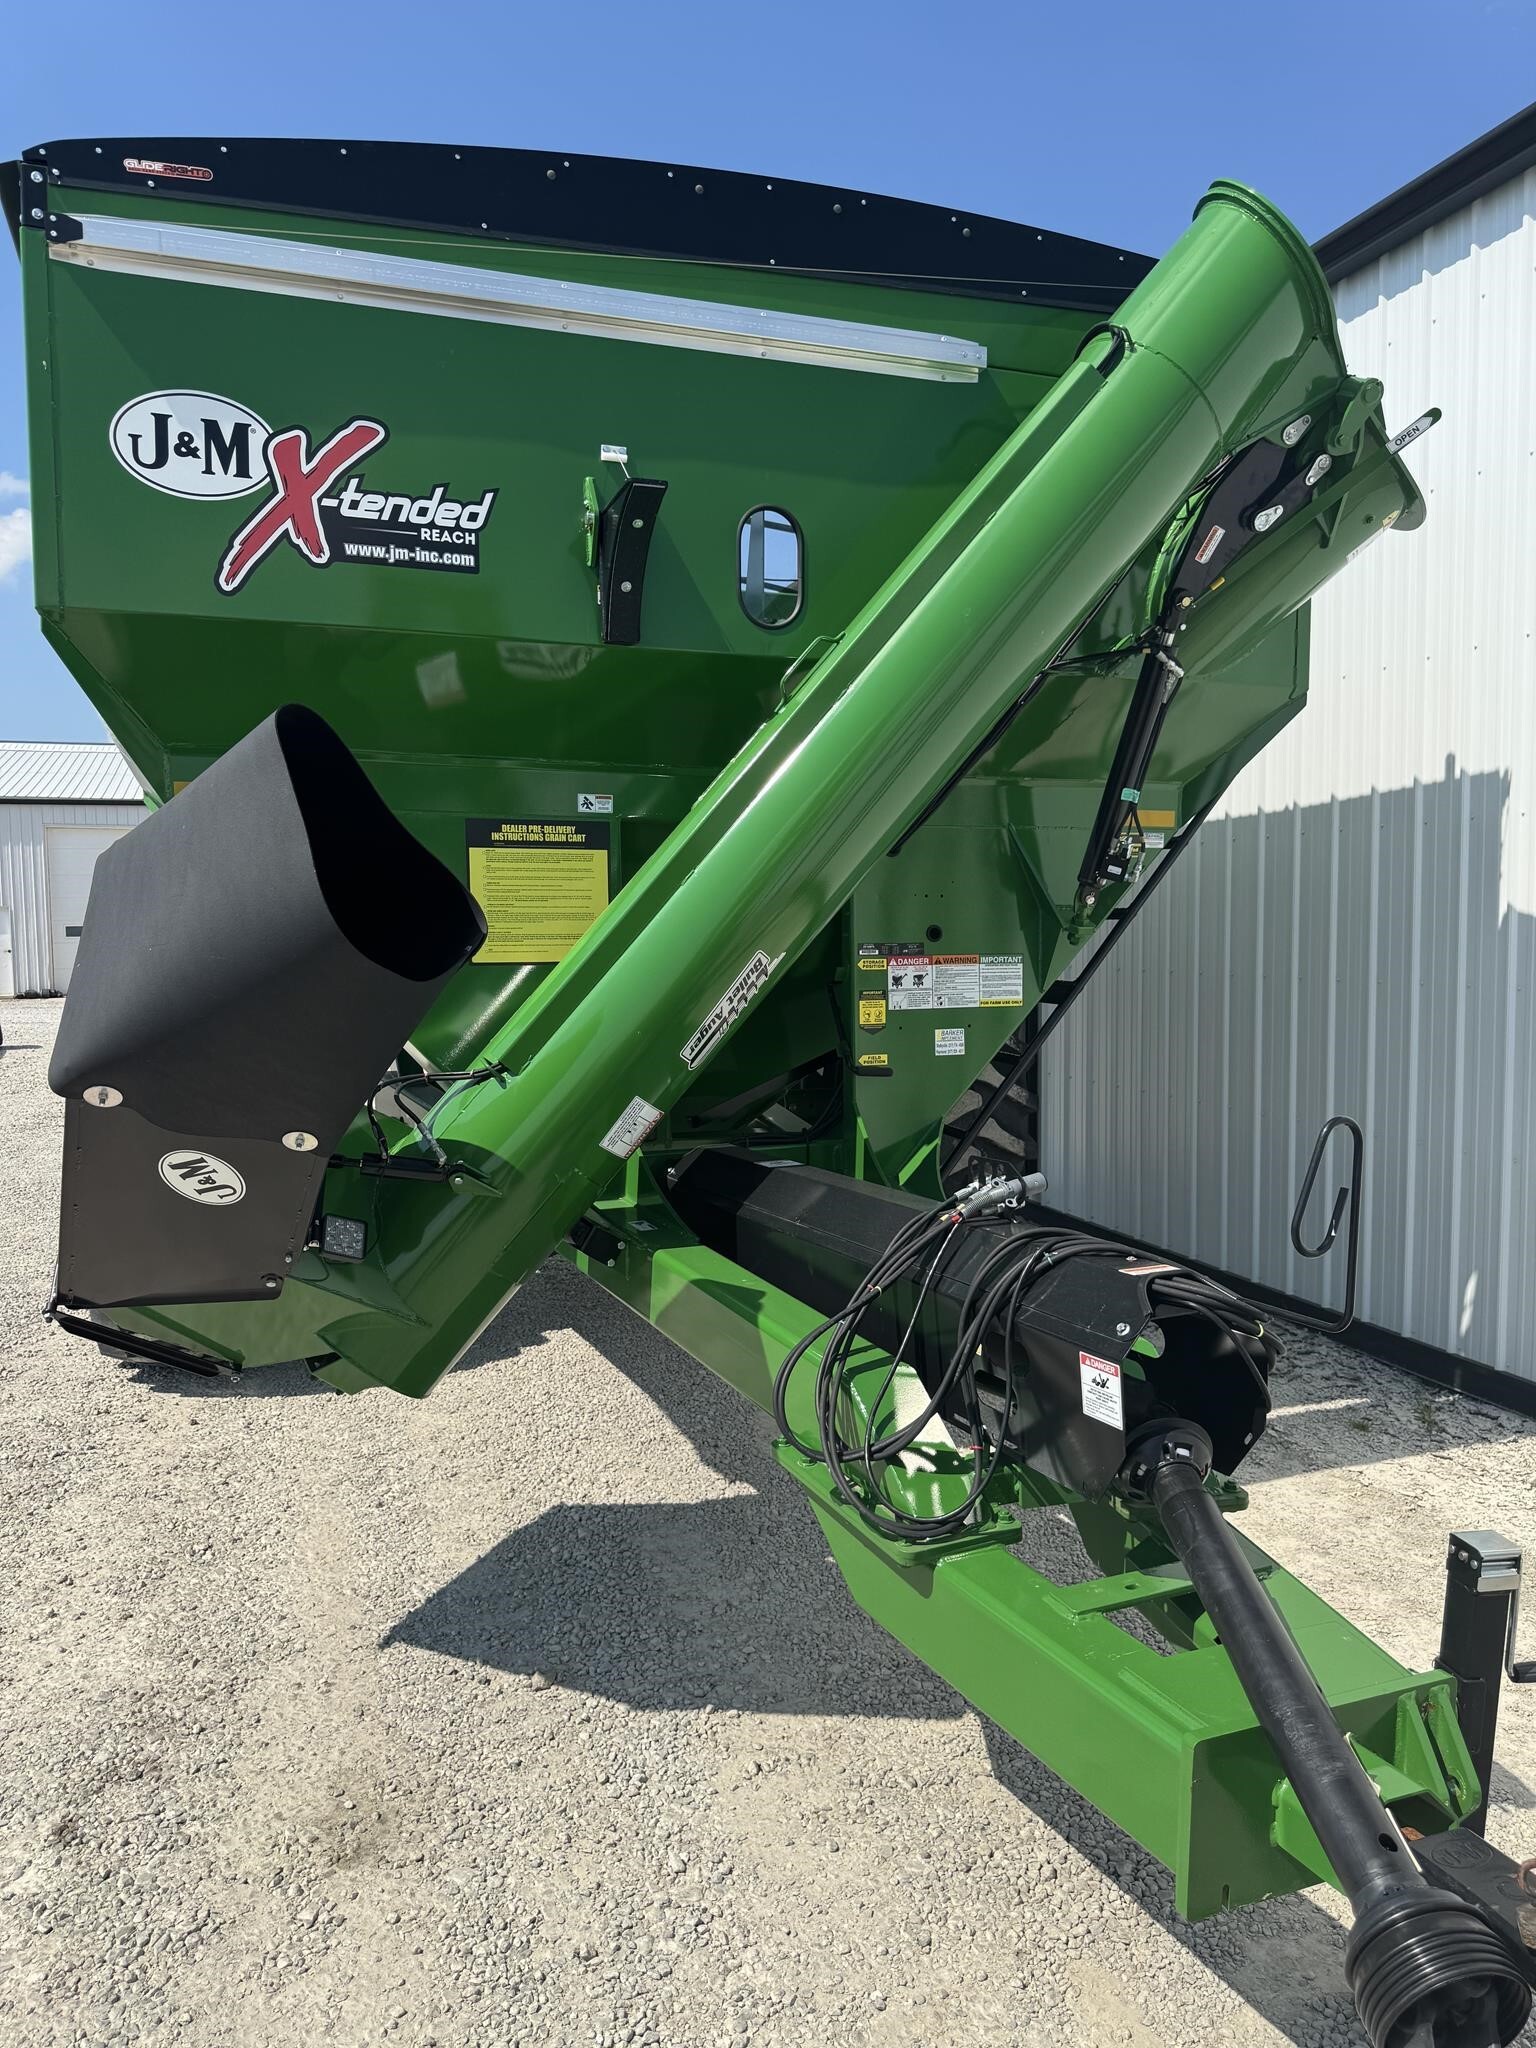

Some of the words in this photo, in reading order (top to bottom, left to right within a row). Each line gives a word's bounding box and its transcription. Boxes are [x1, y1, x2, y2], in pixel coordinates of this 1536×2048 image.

[1394, 425, 1420, 446] OPEN
[128, 412, 252, 479] J&M
[420, 528, 476, 546] REACH
[343, 542, 475, 567] www.jm-inc.com
[491, 832, 544, 842] INSTRUCTIONS
[544, 833, 567, 842] GRAIN
[567, 834, 586, 843] CART
[501, 824, 528, 833] DEALER
[528, 825, 576, 834] PRE-DELIVERY
[942, 956, 977, 964] WARNING
[980, 956, 1022, 964] IMPORTANT
[726, 957, 763, 1006] Bullet
[688, 1006, 723, 1056] Auger
[167, 1156, 237, 1200] J&M
[1090, 1359, 1116, 1376] DANGER
